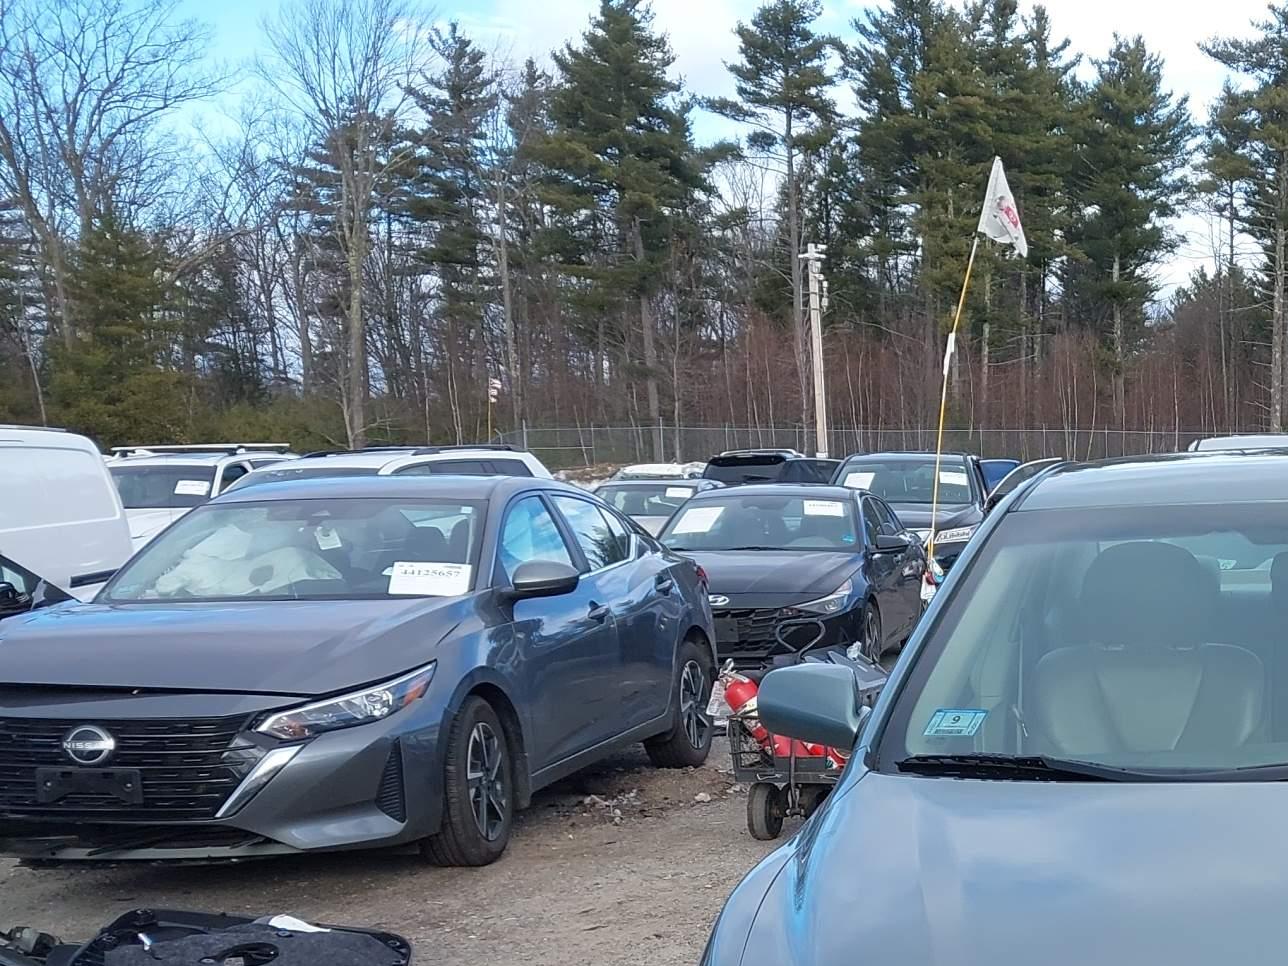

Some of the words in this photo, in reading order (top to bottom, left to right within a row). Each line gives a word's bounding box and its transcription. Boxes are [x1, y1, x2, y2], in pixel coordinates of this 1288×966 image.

[400, 569, 462, 577] 44125657
[951, 715, 961, 725] 9
[63, 741, 112, 749] NISS
